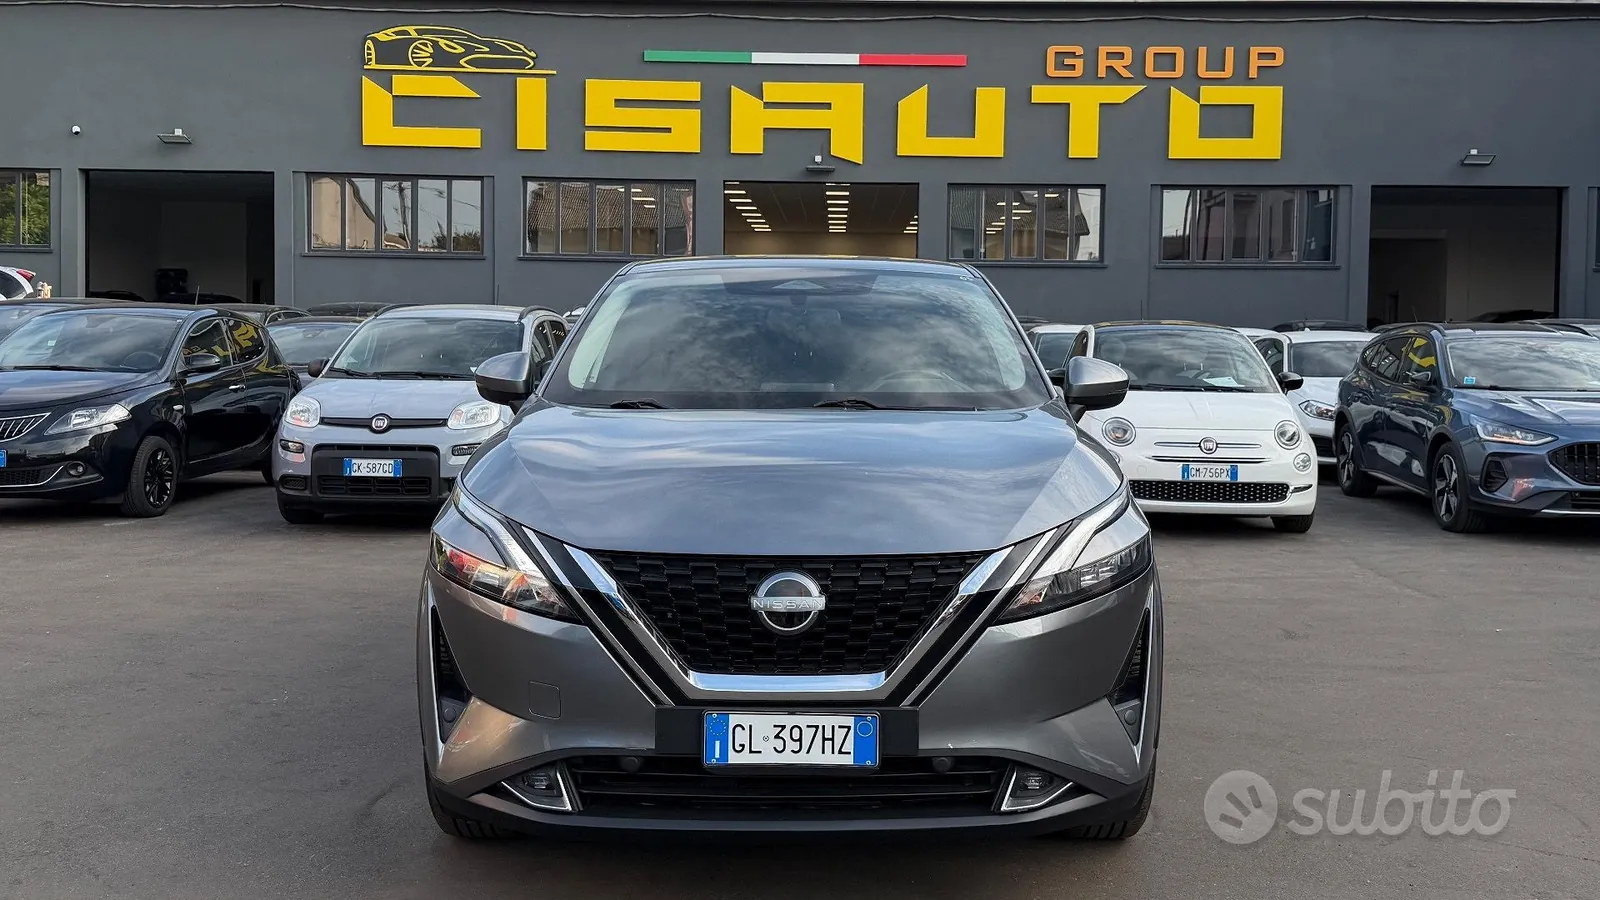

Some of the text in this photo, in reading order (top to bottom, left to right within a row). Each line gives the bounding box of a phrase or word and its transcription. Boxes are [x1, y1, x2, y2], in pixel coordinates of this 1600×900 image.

[1046, 45, 1285, 79] GROUP
[753, 599, 823, 609] NISSAN
[731, 723, 852, 755] GL 397HZ
